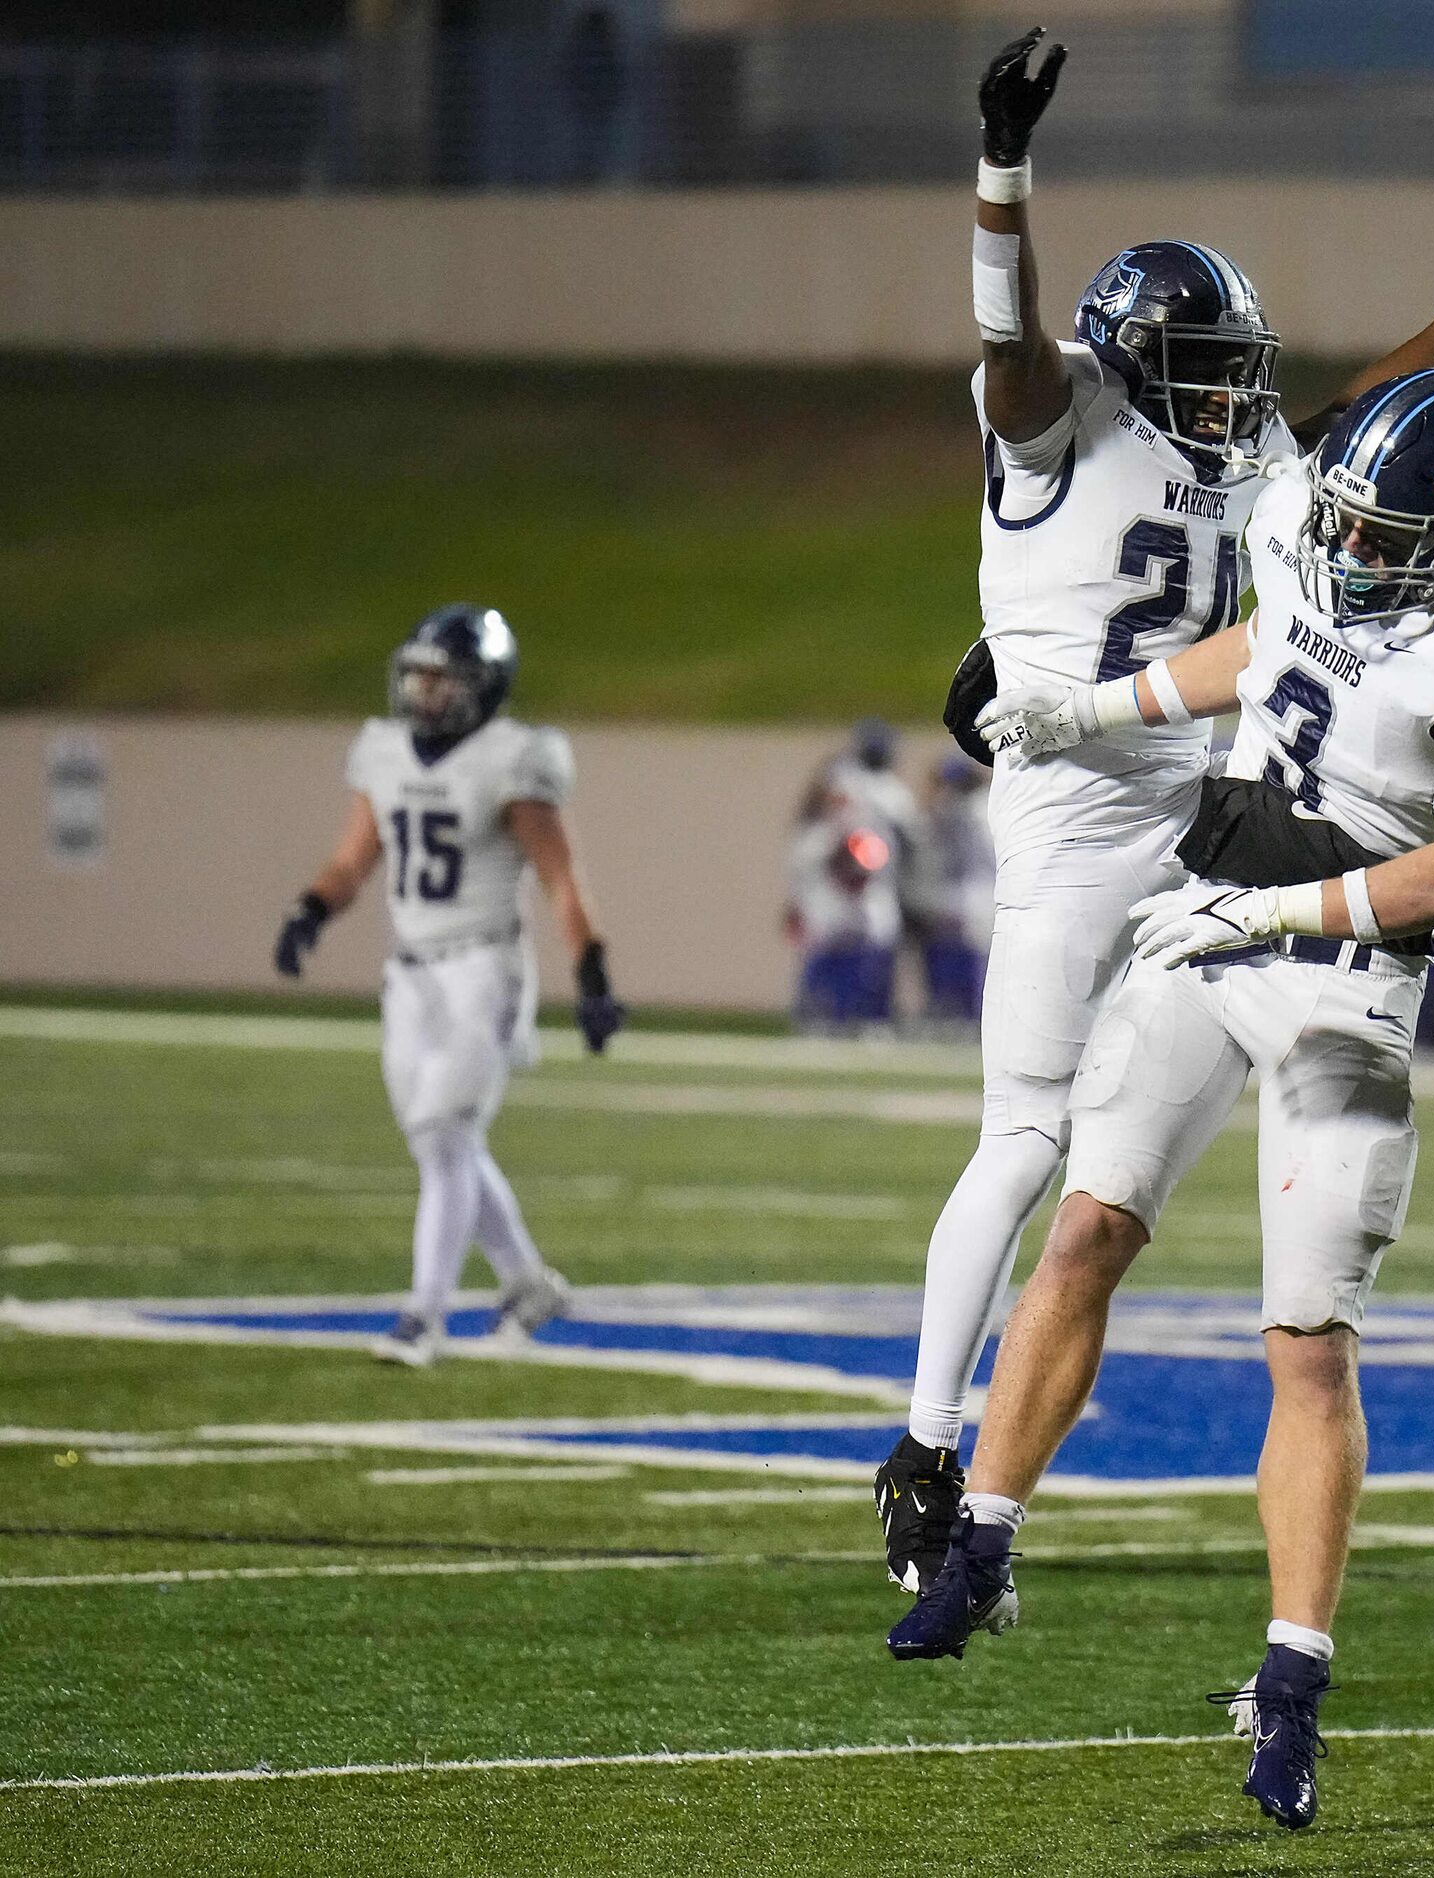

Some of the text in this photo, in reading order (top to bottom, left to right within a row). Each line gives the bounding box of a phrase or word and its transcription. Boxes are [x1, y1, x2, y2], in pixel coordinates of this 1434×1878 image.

[1112, 410, 1157, 445] FOR HIM
[1163, 480, 1229, 520] WARRIORS
[1333, 469, 1368, 497] BE-ONE
[1267, 536, 1283, 560] FOR
[1286, 614, 1367, 688] WARRIORS
[1255, 659, 1338, 814] 3
[391, 808, 464, 902] 15
